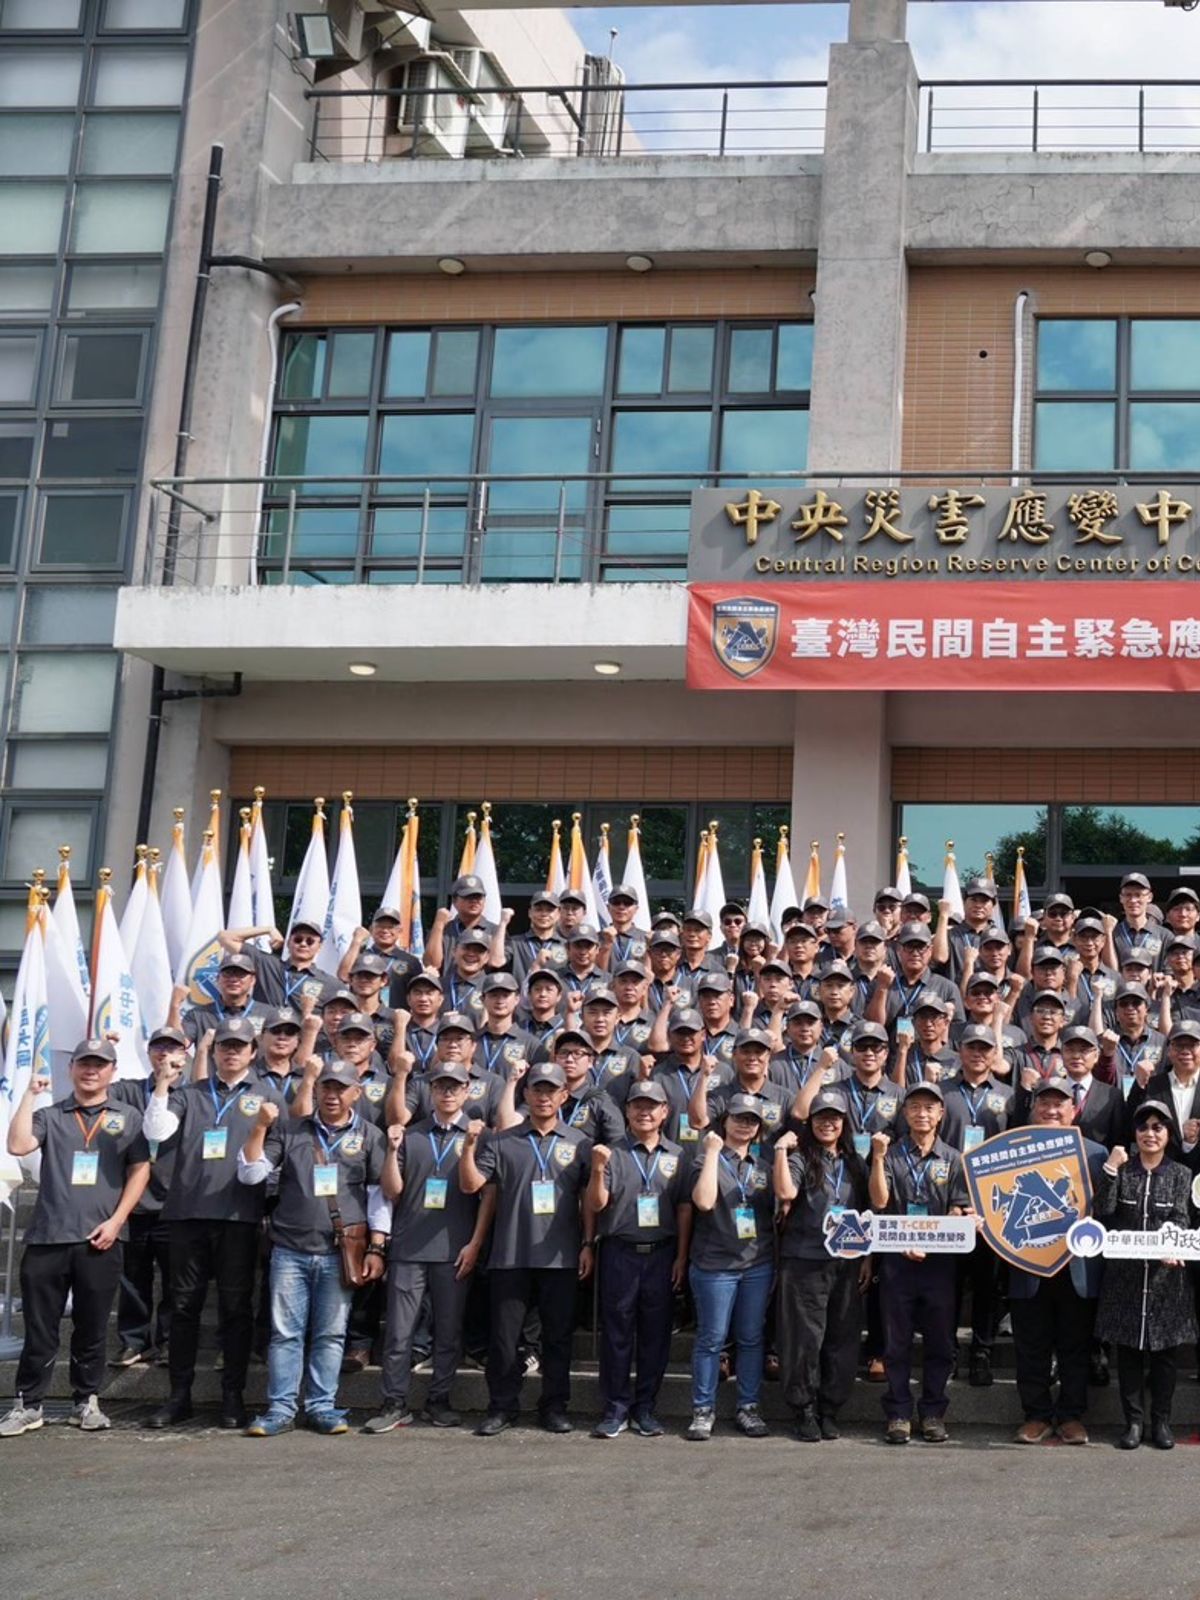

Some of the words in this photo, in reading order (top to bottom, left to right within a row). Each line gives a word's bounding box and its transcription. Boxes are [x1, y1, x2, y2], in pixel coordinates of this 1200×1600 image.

[756, 555, 845, 573] Central
[853, 555, 939, 576] Region
[948, 554, 1049, 573] Reserve
[1057, 554, 1140, 573] Center
[1146, 554, 1172, 573] of
[970, 1134, 1075, 1167] 臺灣民間自主緊急應變隊
[900, 1219, 940, 1231] T-CERT
[878, 1231, 967, 1243] 民間自主緊急應變隊
